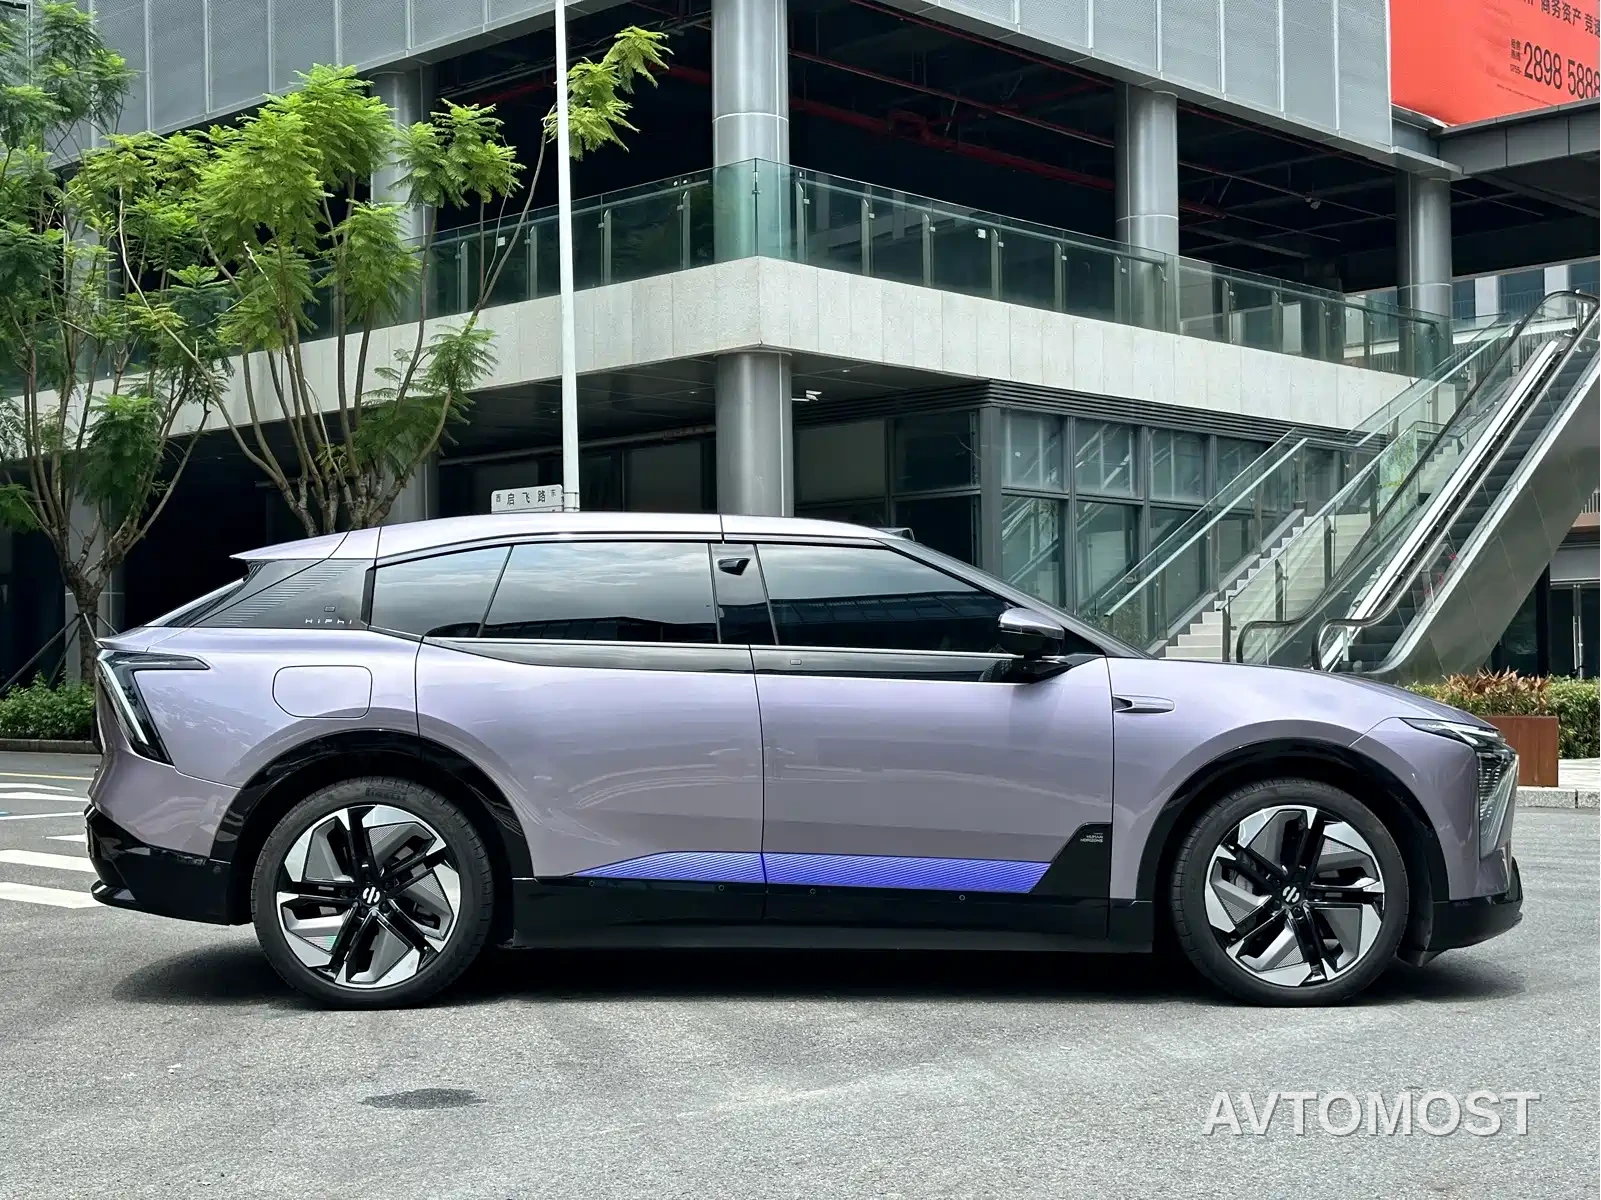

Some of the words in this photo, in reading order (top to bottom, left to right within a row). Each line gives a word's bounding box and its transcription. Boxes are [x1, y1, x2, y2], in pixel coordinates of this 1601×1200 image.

[1524, 41, 1562, 90] 2898
[507, 489, 546, 506] 启飞路
